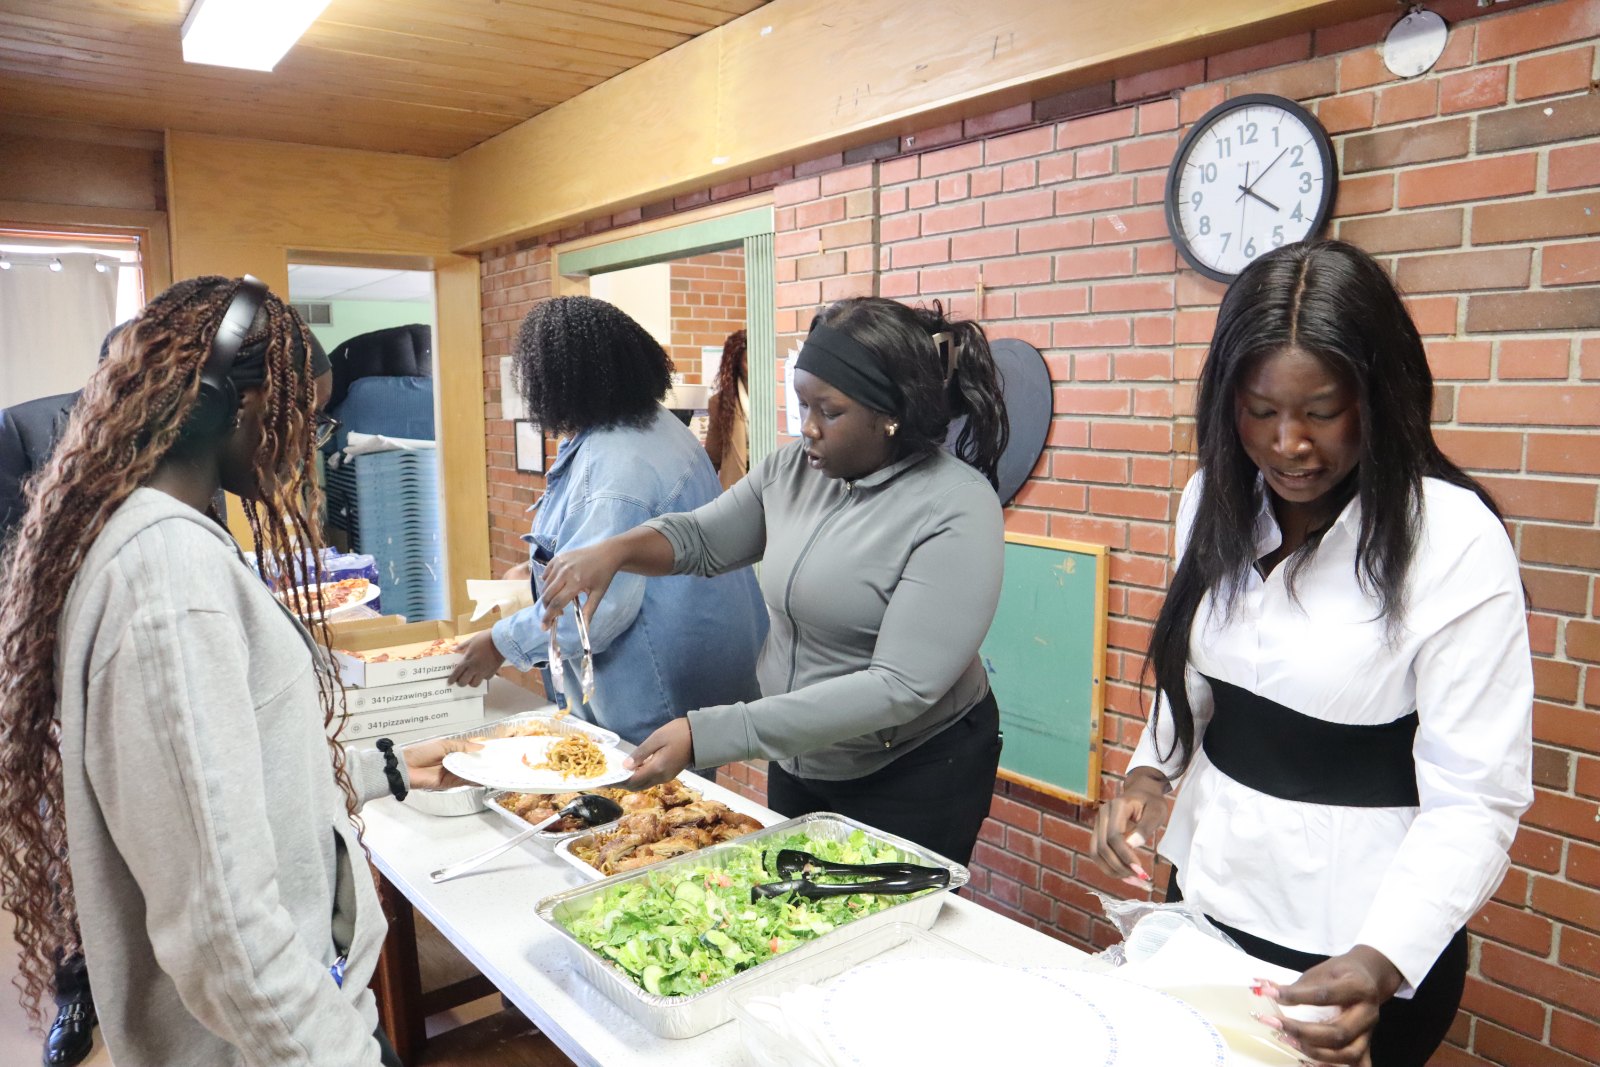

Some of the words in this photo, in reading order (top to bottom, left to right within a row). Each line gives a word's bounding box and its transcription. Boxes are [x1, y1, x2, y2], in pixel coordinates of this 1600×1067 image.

[1237, 122, 1258, 145] 12
[1272, 126, 1279, 147] 1
[1216, 137, 1231, 159] 11
[1290, 145, 1304, 168] 2
[1198, 162, 1217, 184] 10
[1298, 171, 1312, 194] 3
[1191, 191, 1203, 212] 9
[1289, 199, 1303, 222] 4
[1199, 215, 1211, 236] 8
[1271, 225, 1284, 247] 5
[1220, 232, 1232, 253] 7
[1244, 236, 1256, 259] 6
[371, 687, 452, 705] 341pizzawings.com
[367, 711, 449, 730] 341pizzawings.com
